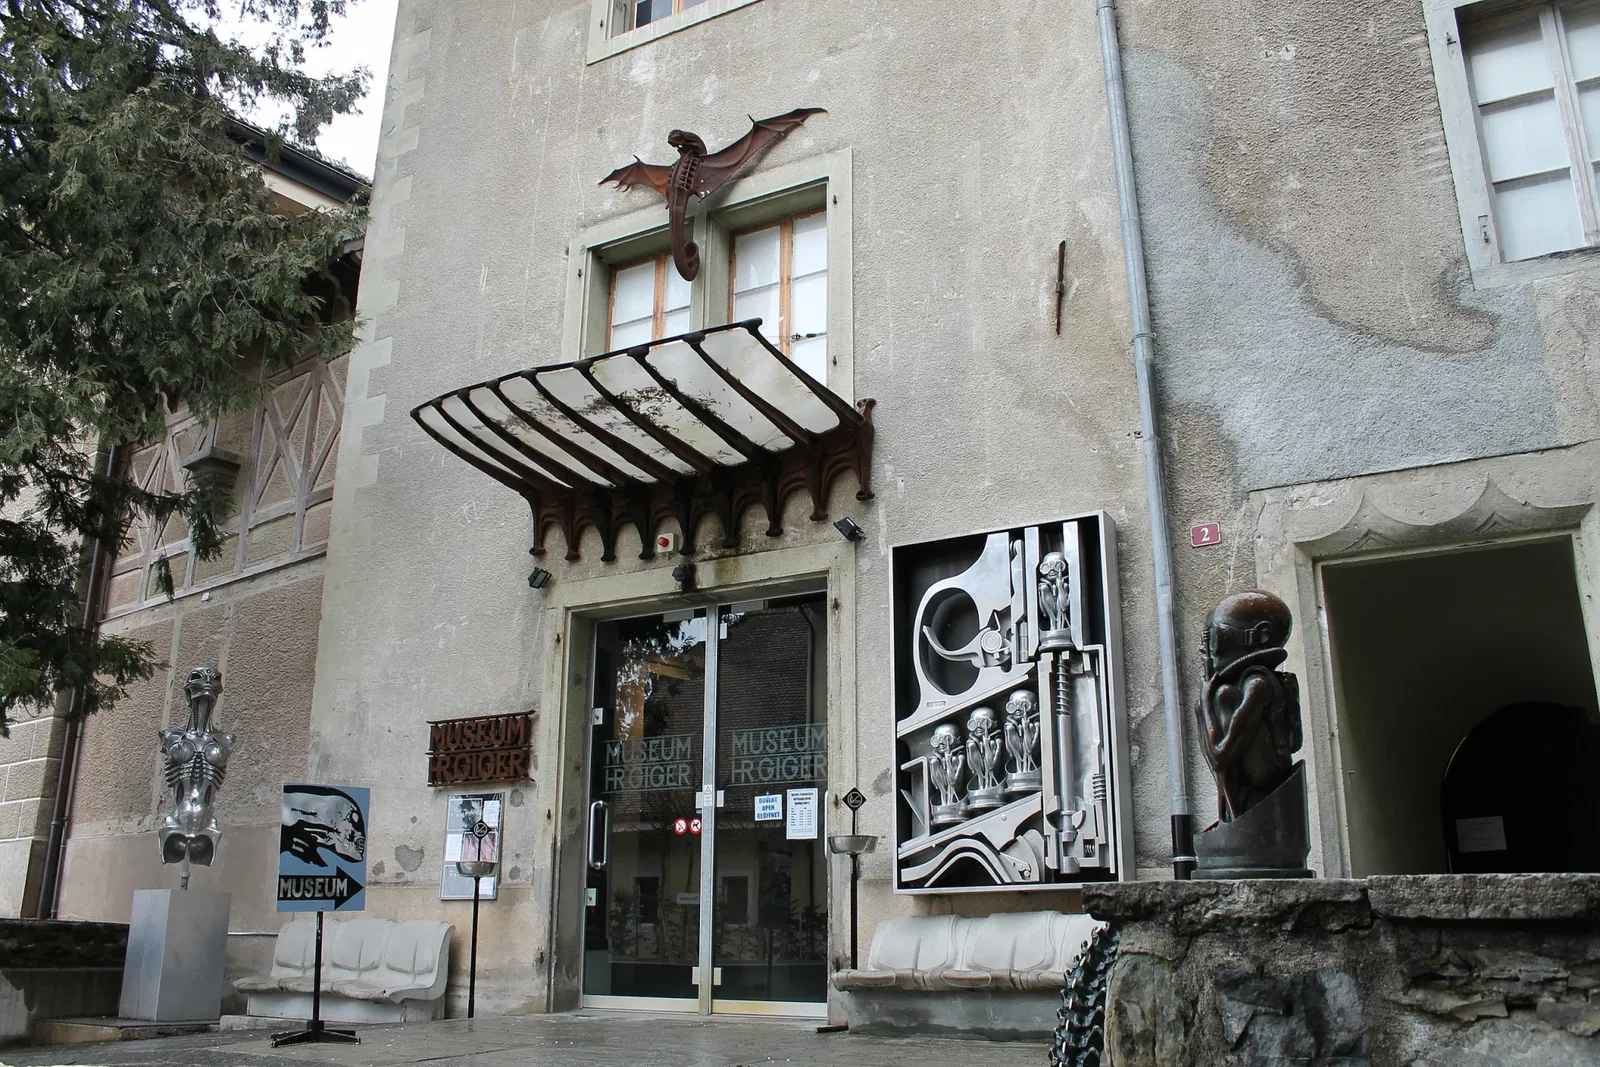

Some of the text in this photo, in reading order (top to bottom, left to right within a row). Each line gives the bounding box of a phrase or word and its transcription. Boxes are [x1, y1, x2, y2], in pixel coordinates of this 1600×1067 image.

[1200, 527, 1210, 542] 2
[431, 717, 526, 751] MUSEUM
[732, 726, 827, 755] MUSEUM
[605, 736, 692, 765] MUSEUM
[279, 878, 348, 898] MUSEUM
